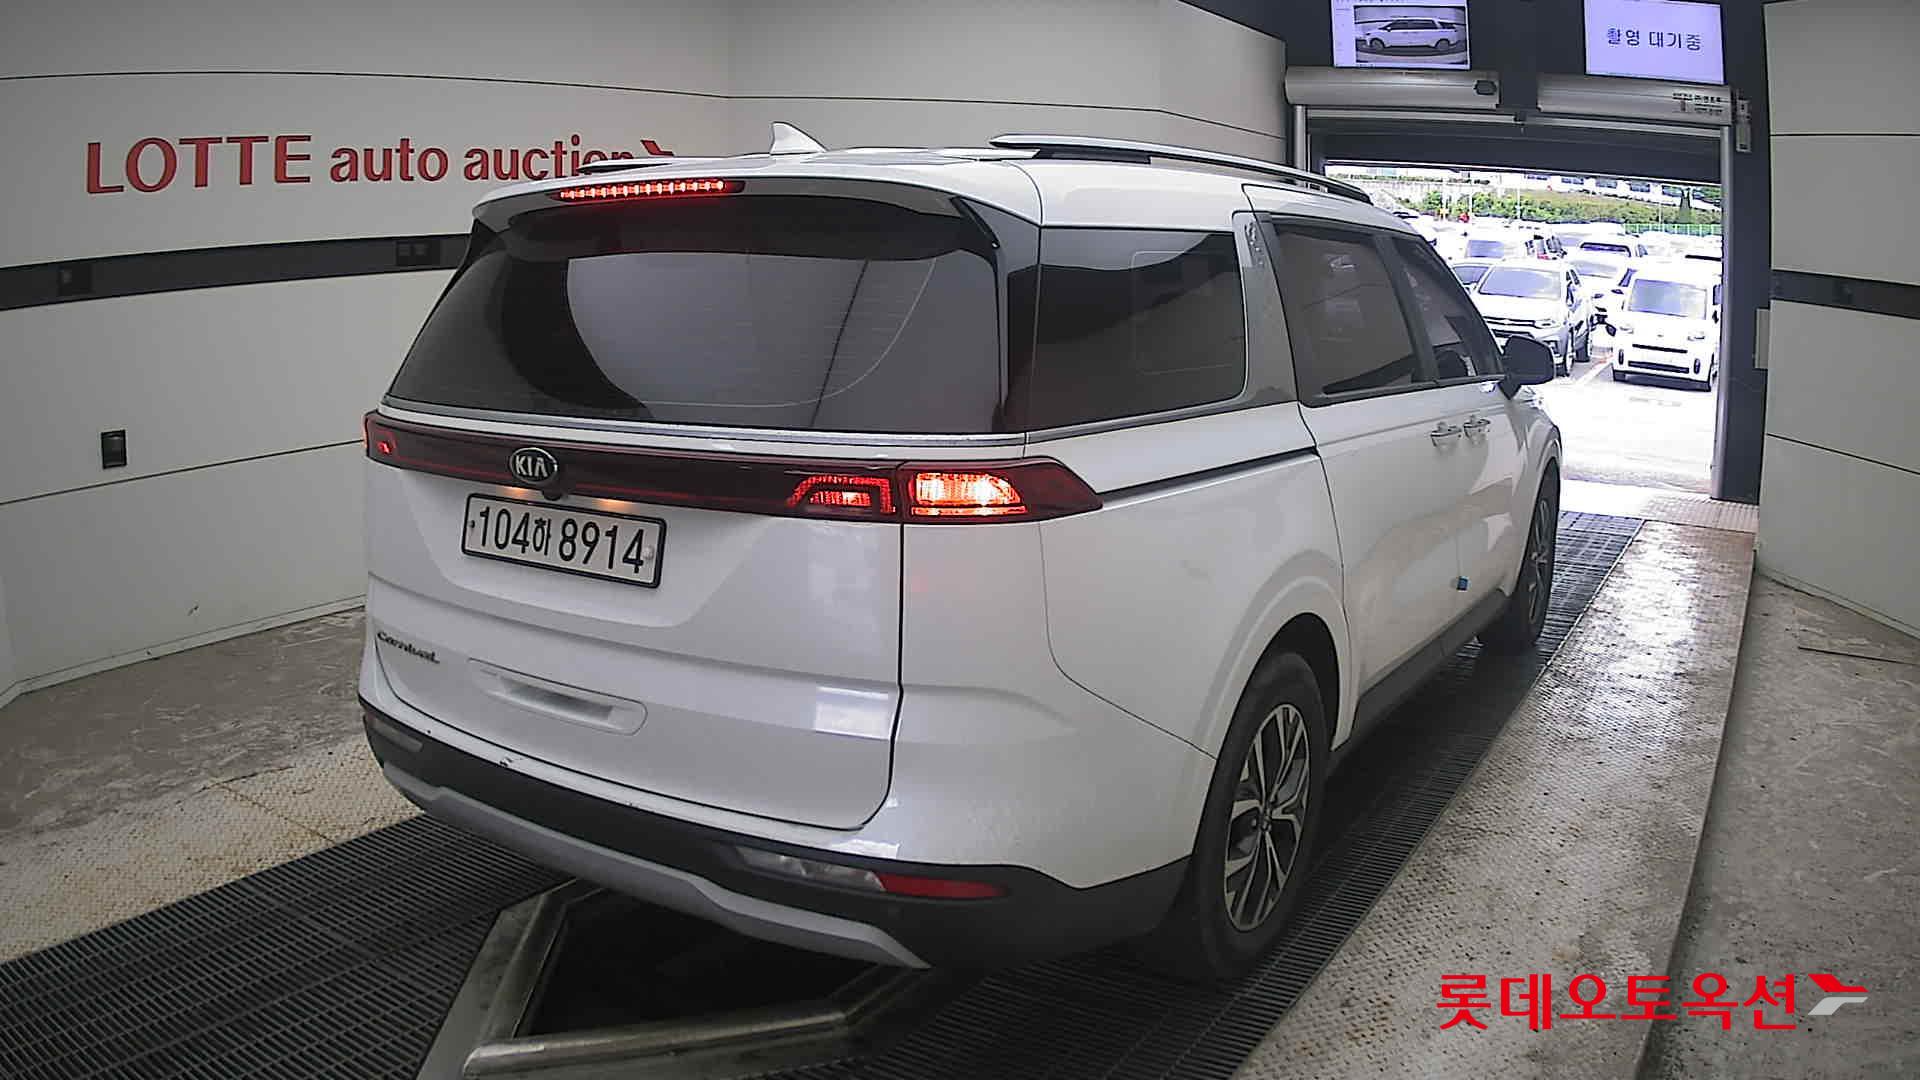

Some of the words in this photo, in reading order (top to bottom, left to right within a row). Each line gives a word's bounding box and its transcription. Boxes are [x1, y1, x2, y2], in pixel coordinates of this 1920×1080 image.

[86, 135, 312, 194] LOTTE
[330, 138, 449, 182] auto
[464, 134, 634, 181] aucti
[515, 455, 548, 478] KIA
[558, 518, 645, 574] 8914
